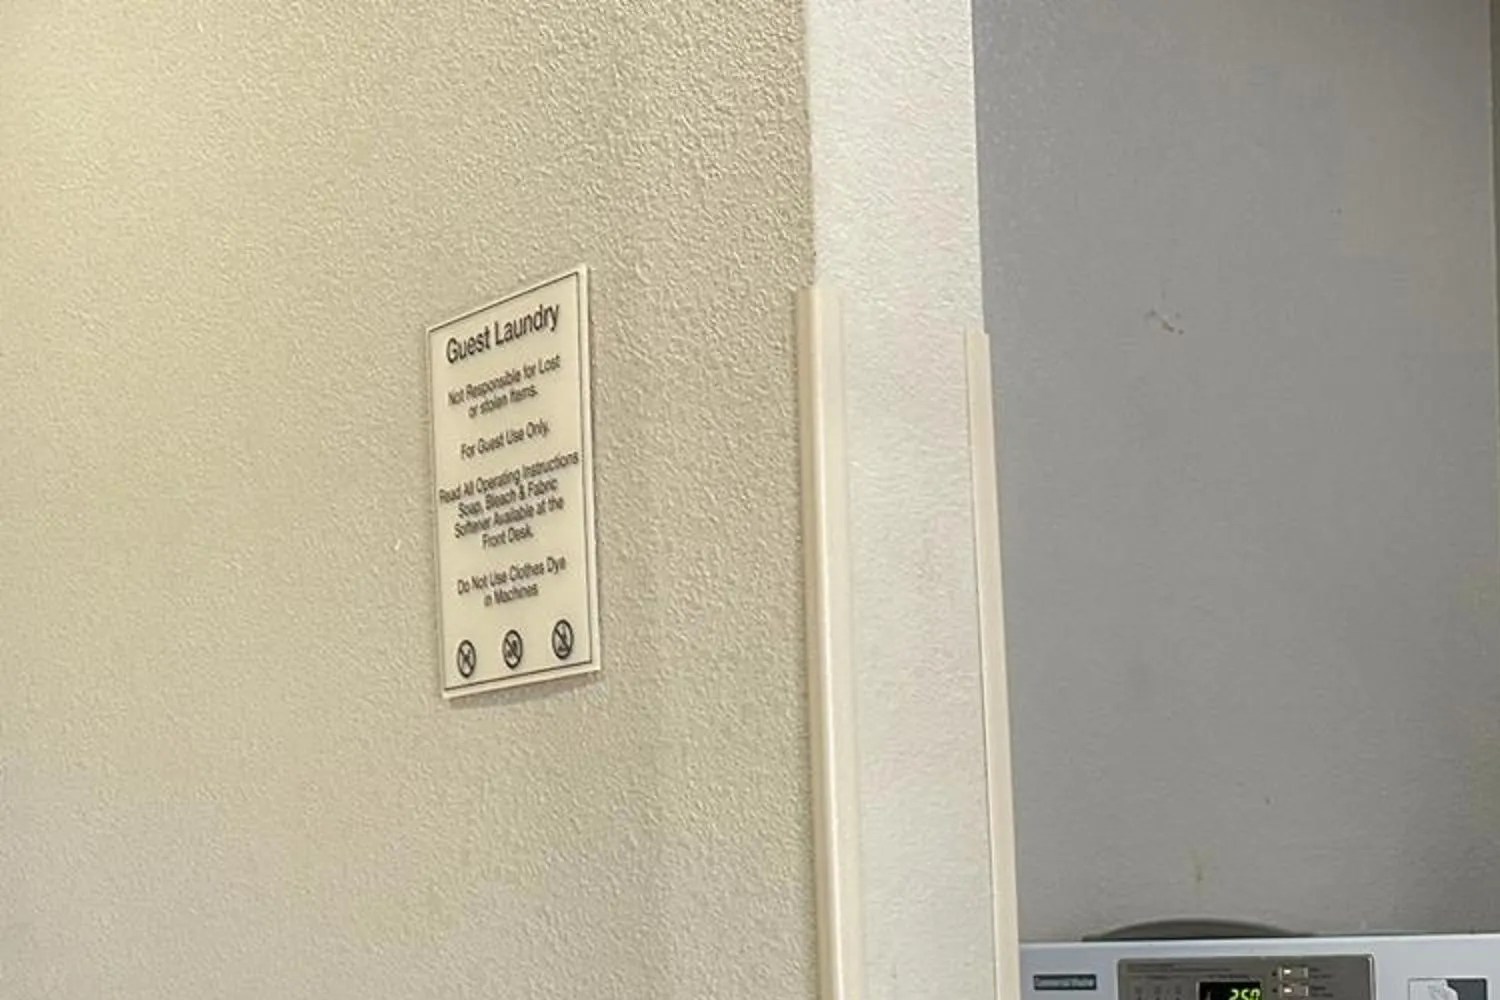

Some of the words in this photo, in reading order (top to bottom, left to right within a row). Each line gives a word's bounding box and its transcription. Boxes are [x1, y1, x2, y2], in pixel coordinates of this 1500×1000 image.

[446, 325, 490, 363] Guest
[494, 304, 559, 345] Laundry
[447, 388, 464, 405] Not
[466, 368, 521, 401] Responsible
[523, 362, 536, 380] for
[538, 354, 561, 374] Lost
[467, 403, 478, 418] or
[480, 394, 508, 415] stolen
[461, 443, 475, 460] For
[477, 433, 504, 455] Guest
[506, 428, 525, 445] Use
[439, 485, 461, 503] Read
[463, 480, 475, 496] All
[475, 469, 520, 494] Operating
[522, 452, 579, 480] Instructions
[485, 488, 516, 511] Bleach
[528, 479, 558, 497] Fabric
[454, 517, 491, 539] Softener
[493, 503, 534, 525] Available
[536, 499, 547, 515] at
[548, 497, 564, 512] the
[482, 530, 506, 549] Front
[457, 578, 470, 595] Do
[472, 574, 488, 590] Not
[490, 570, 507, 586] Use
[509, 561, 545, 582] Clothes
[547, 555, 567, 575] Dye
[494, 583, 539, 605] Machines
